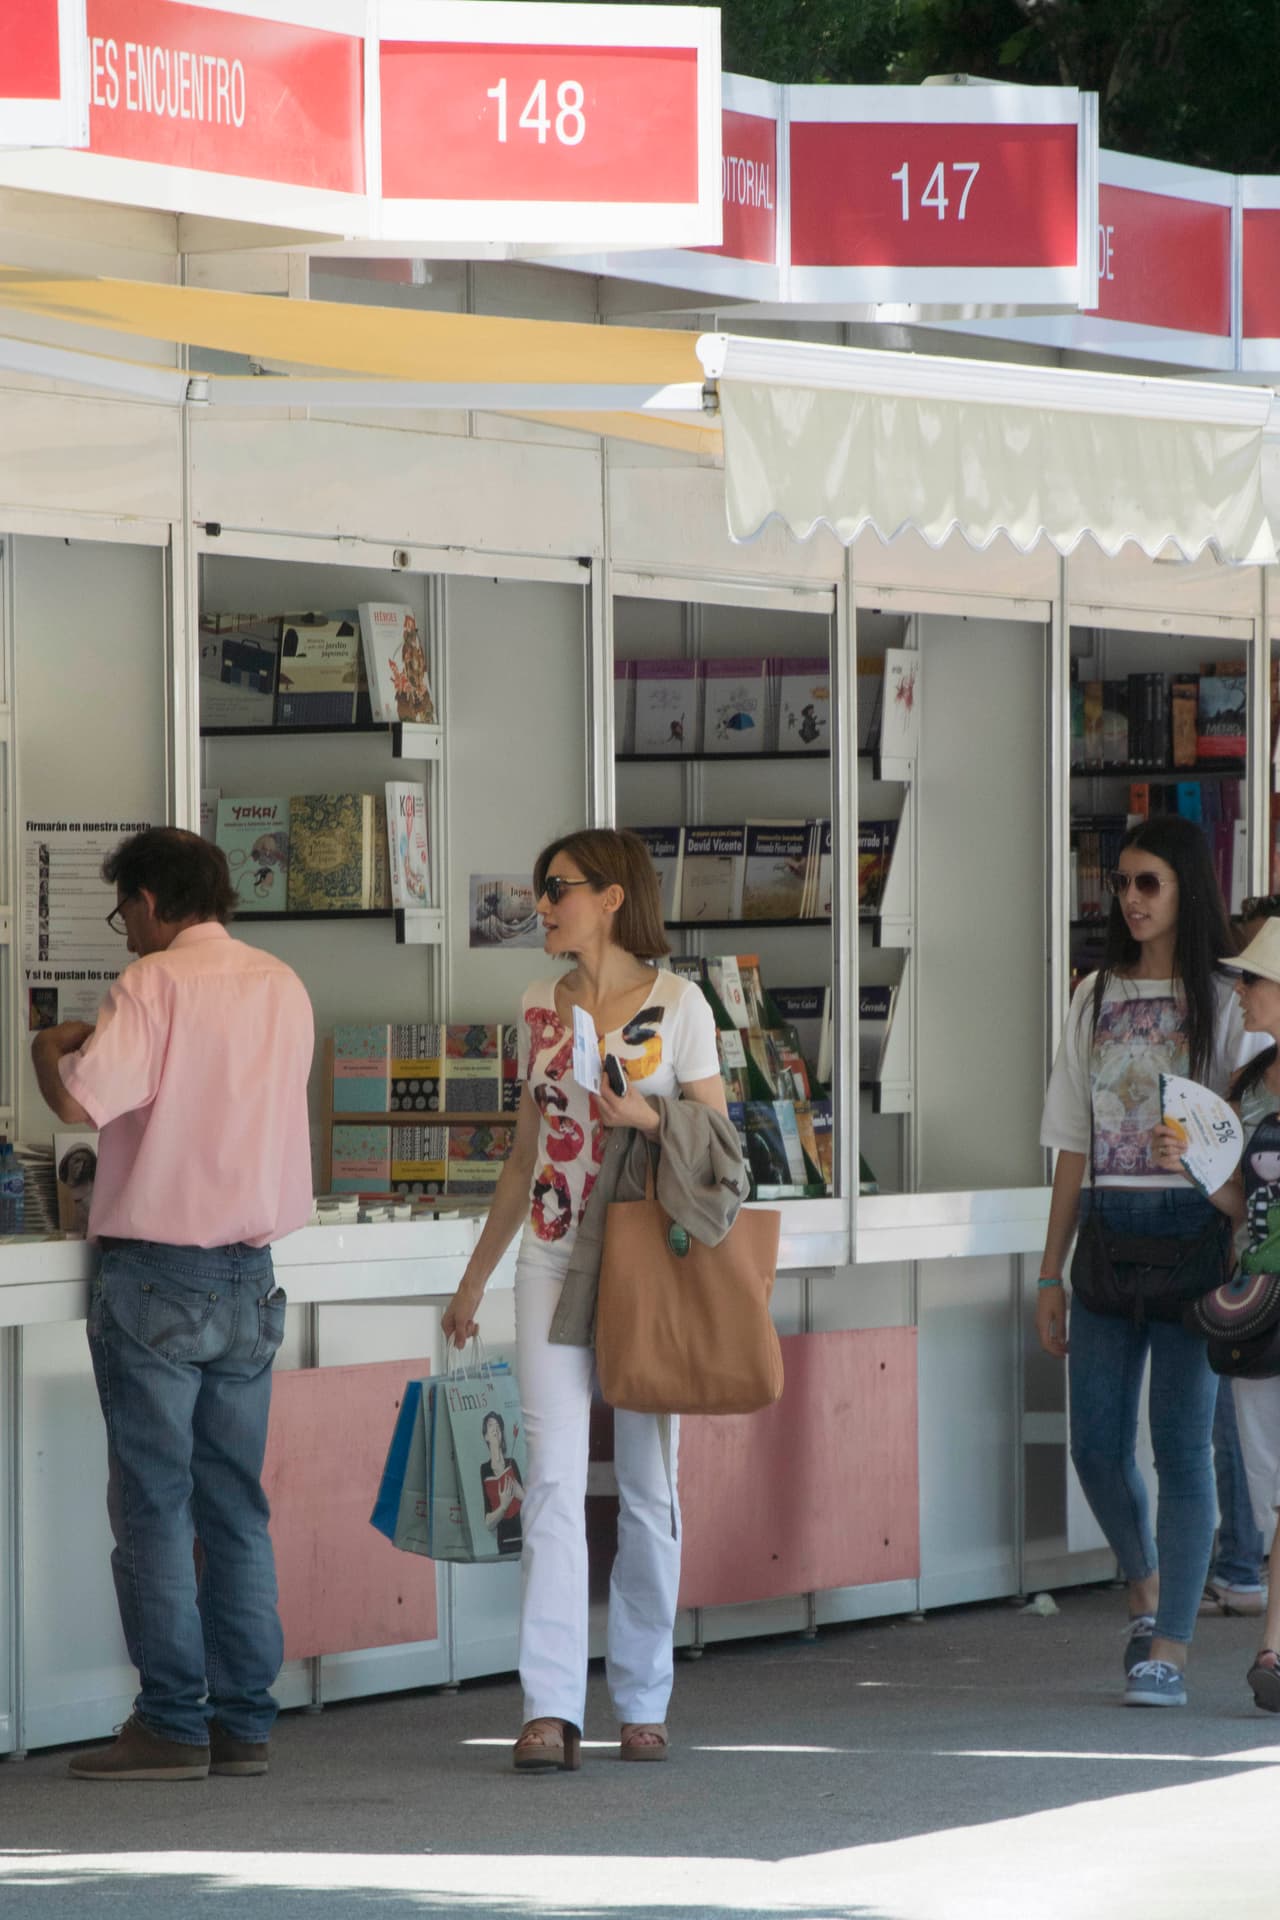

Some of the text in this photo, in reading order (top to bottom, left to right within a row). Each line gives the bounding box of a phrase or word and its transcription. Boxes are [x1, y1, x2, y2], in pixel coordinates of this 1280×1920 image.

[125, 42, 246, 128] ENCUENTRO
[487, 77, 586, 146] 148
[891, 161, 980, 221] 147
[25, 820, 67, 832] Firmarán
[69, 823, 80, 832] en
[82, 822, 118, 832] nuestra
[688, 838, 742, 851] David Vicente
[25, 969, 31, 980] Y
[32, 969, 41, 980] si
[43, 970, 52, 980] te
[54, 970, 86, 982] gustan
[87, 969, 102, 980] los
[1212, 1120, 1238, 1144] 5%
